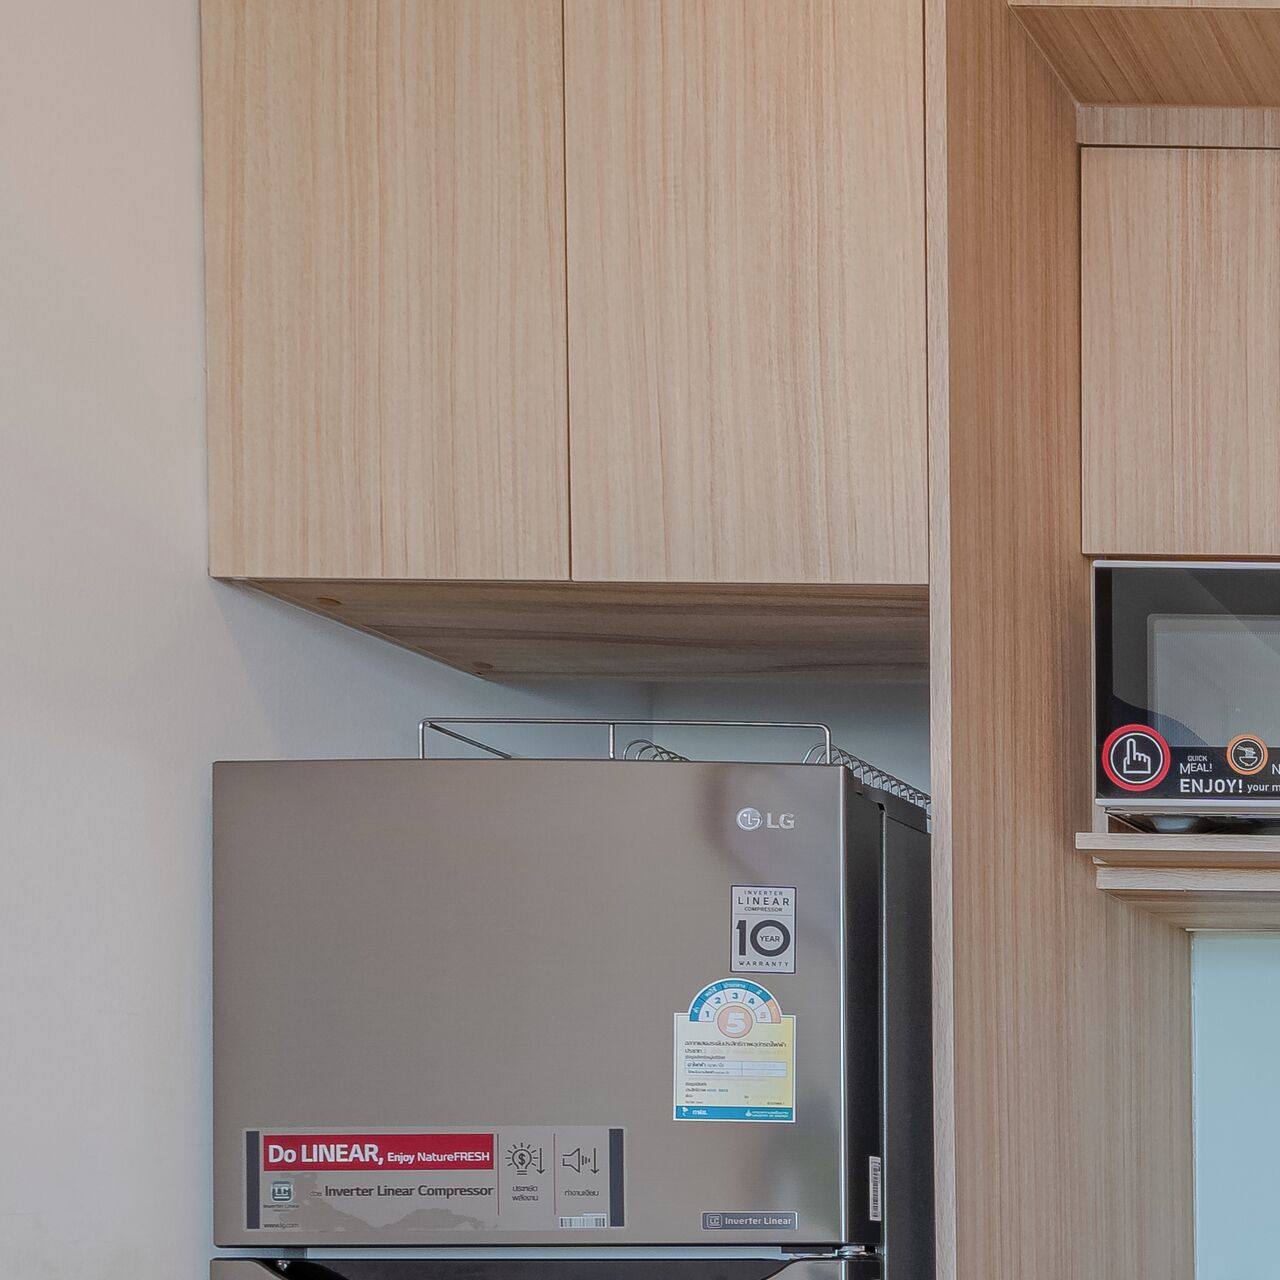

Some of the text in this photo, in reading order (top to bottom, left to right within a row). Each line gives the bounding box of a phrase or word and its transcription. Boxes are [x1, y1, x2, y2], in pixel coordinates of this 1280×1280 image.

[1180, 762, 1213, 775] MEAL!
[1180, 778, 1243, 793] ENJOY!
[1246, 783, 1269, 794] your
[738, 896, 790, 907] LINEAR
[736, 919, 791, 958] 10
[759, 935, 781, 943] YEAR
[738, 960, 789, 968] WARRANTY
[714, 996, 721, 1005] 2
[732, 992, 739, 1000] 3
[748, 997, 755, 1005] 4
[705, 1010, 710, 1018] 1
[760, 1011, 767, 1020] 5
[726, 1011, 746, 1034] 5
[268, 1143, 490, 1166] Do LINEAR, Enjoy NatureFRESH
[324, 1185, 374, 1197] Inverter
[377, 1185, 415, 1197] Linear
[418, 1184, 494, 1199] Compressor
[725, 1217, 793, 1225] Inverter Linear
